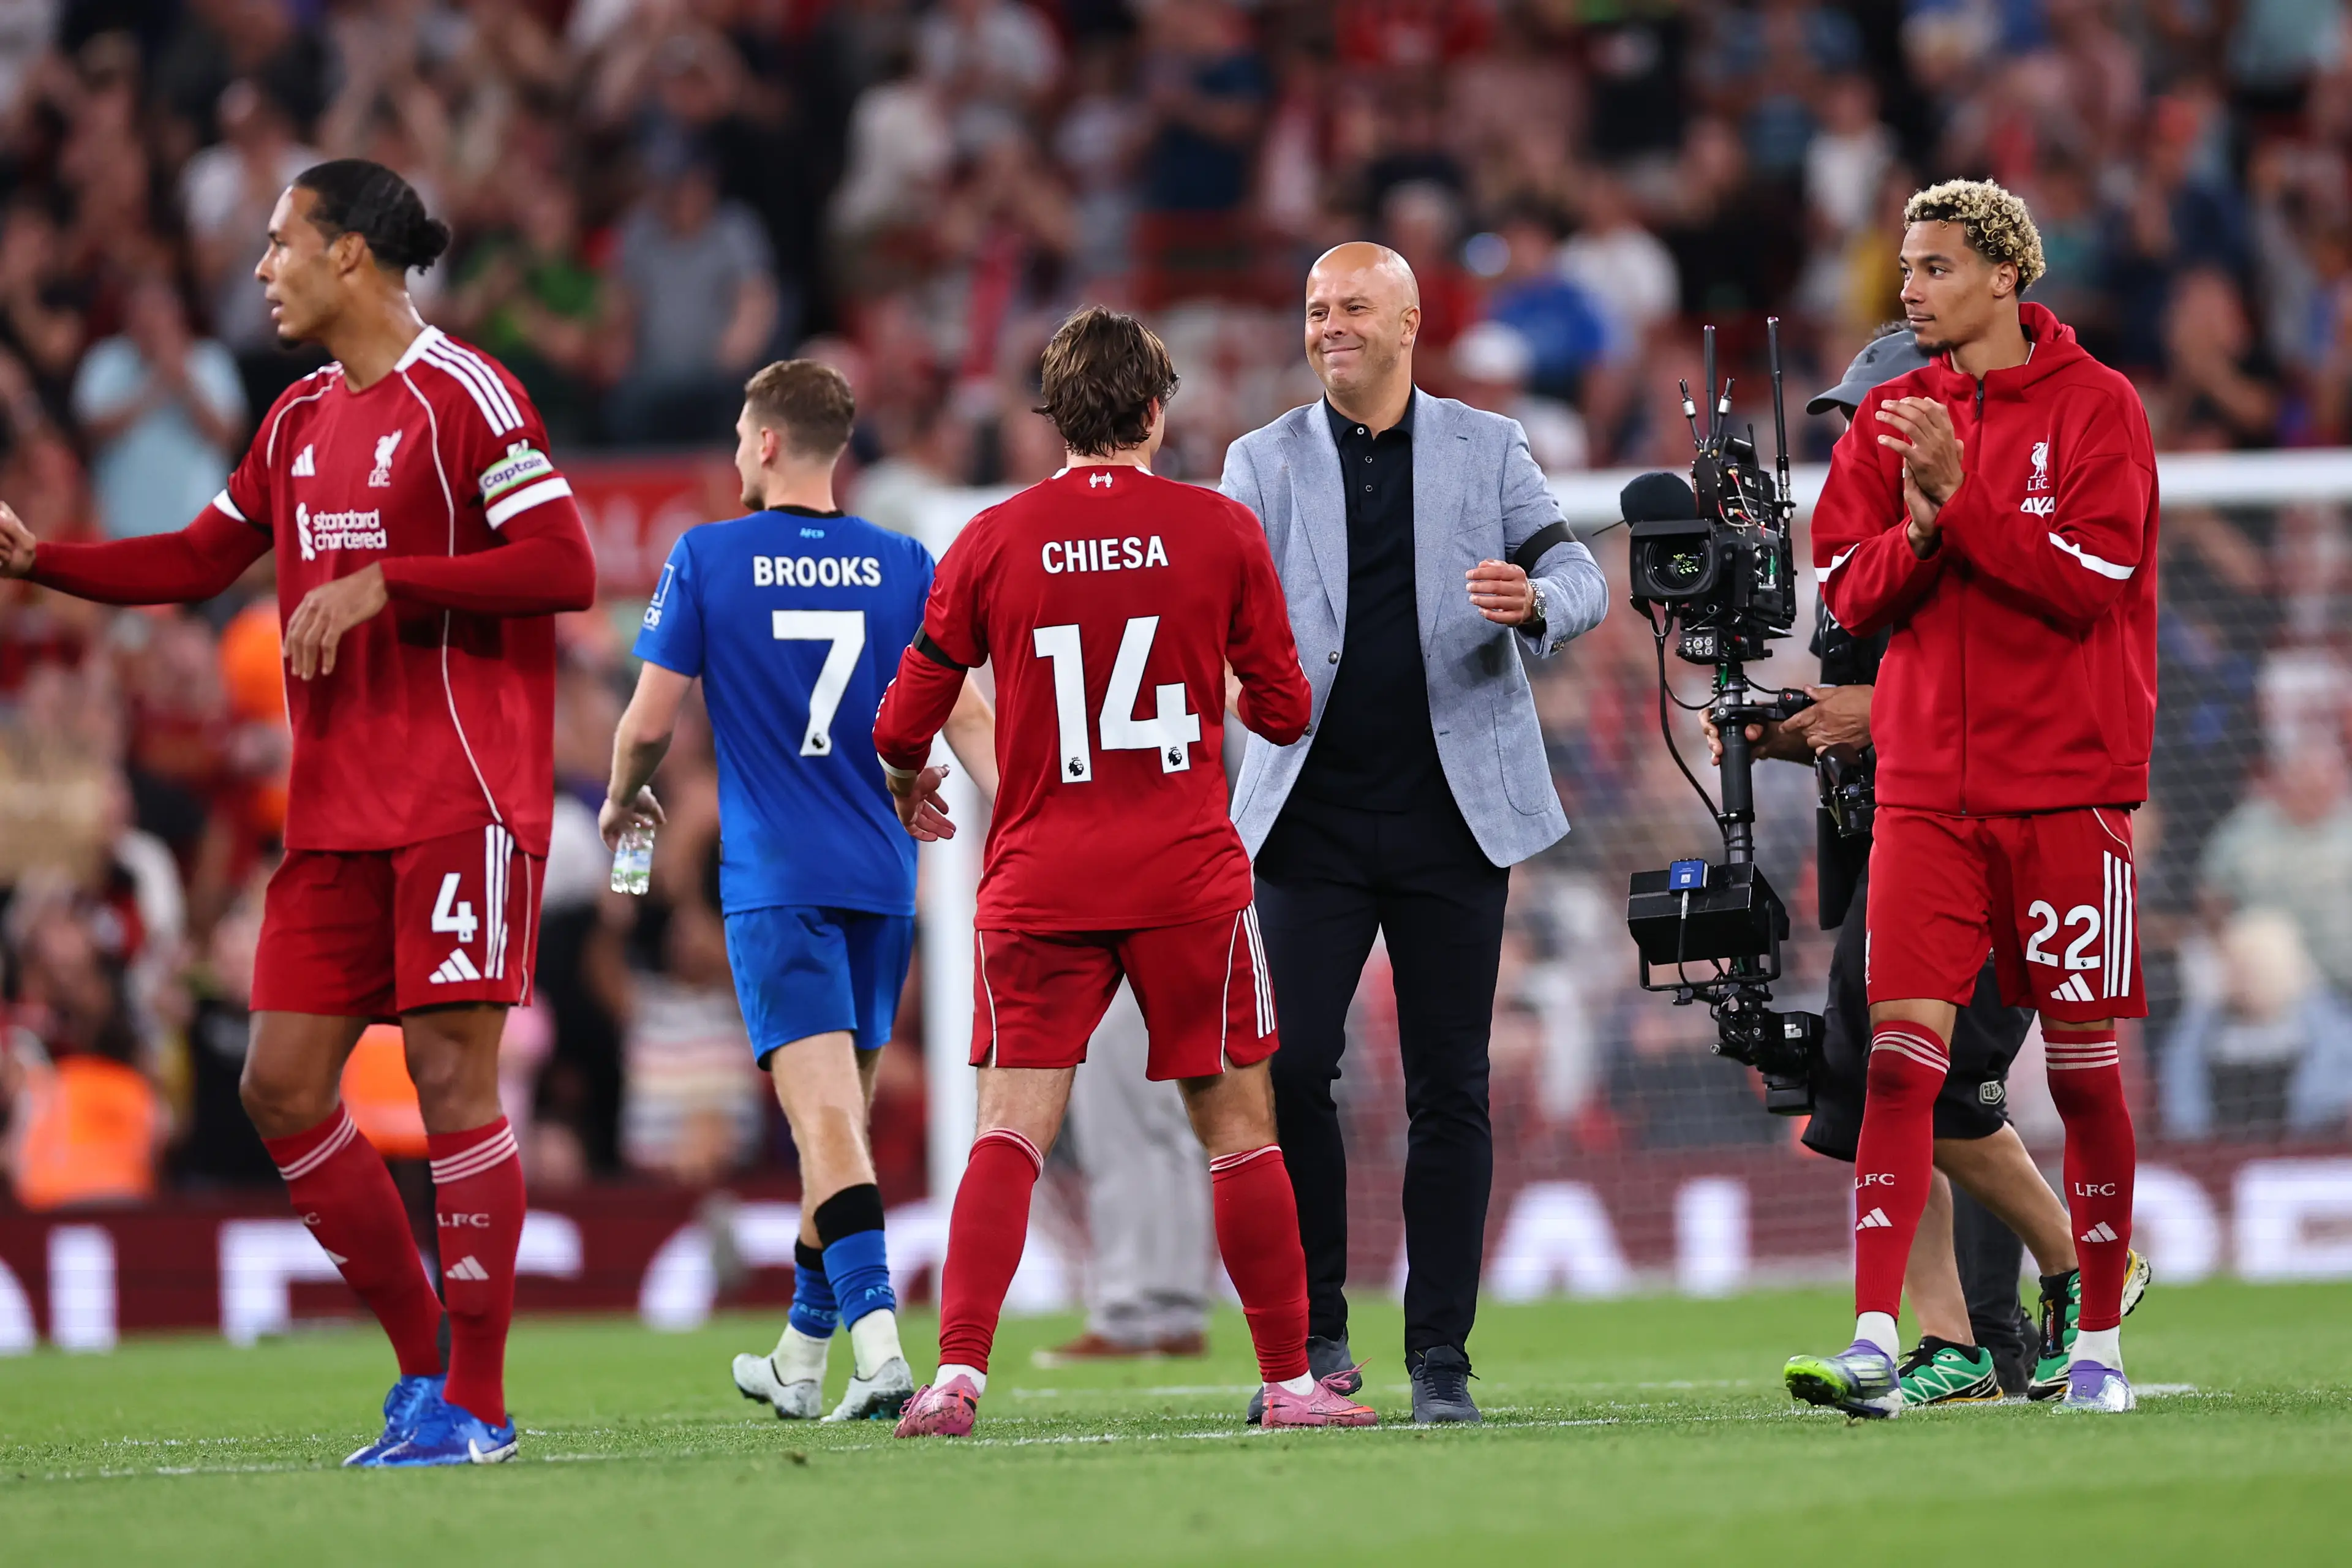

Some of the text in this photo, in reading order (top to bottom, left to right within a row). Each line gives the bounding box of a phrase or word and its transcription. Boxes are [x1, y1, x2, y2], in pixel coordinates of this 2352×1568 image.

[313, 508, 380, 531] standard
[314, 527, 387, 551] chartered
[1041, 535, 1169, 575] CHIESA
[753, 555, 882, 587] BROOKS
[772, 609, 865, 756] 7
[1033, 615, 1201, 783] 14
[431, 872, 478, 943] 4
[2026, 899, 2101, 970] 22
[1855, 1173, 1895, 1190] LFC
[2075, 1182, 2116, 1197] LFC
